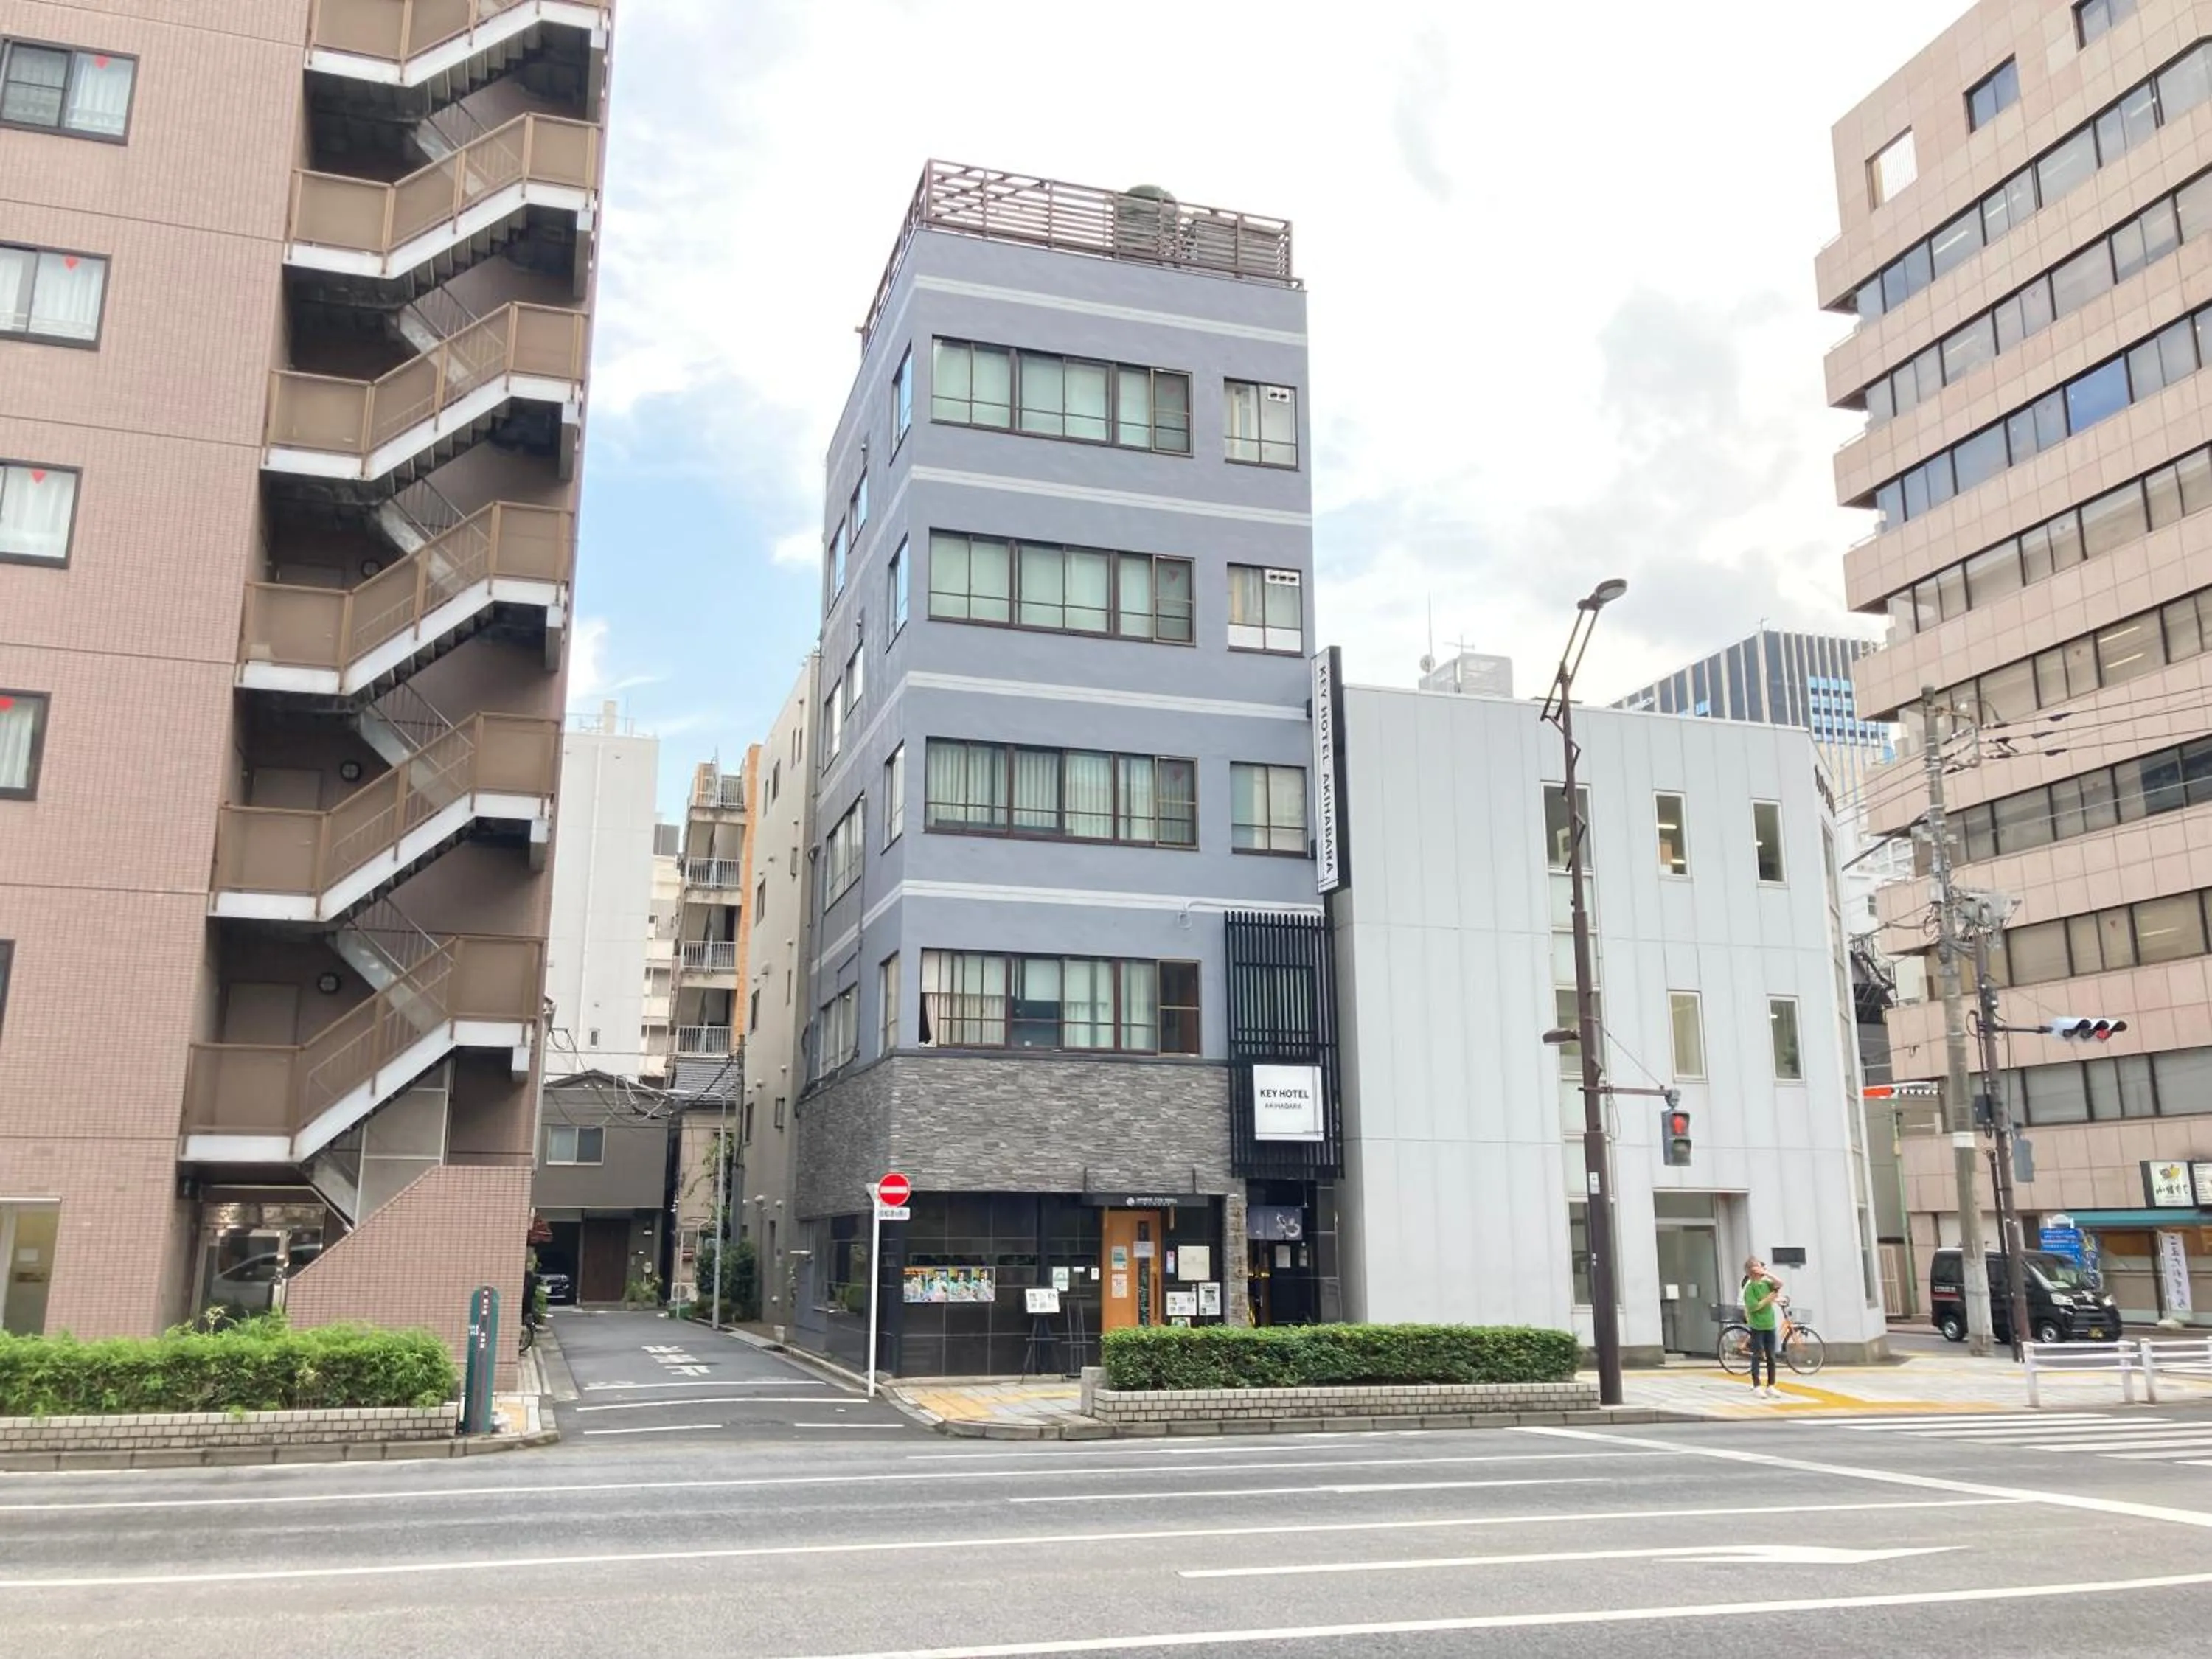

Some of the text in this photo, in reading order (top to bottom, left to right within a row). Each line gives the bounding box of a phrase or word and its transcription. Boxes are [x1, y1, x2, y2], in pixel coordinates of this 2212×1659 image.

[1318, 665, 1334, 874] KEY HOTEL AKIHABARA
[1260, 1089, 1309, 1099] KEY HOTEL
